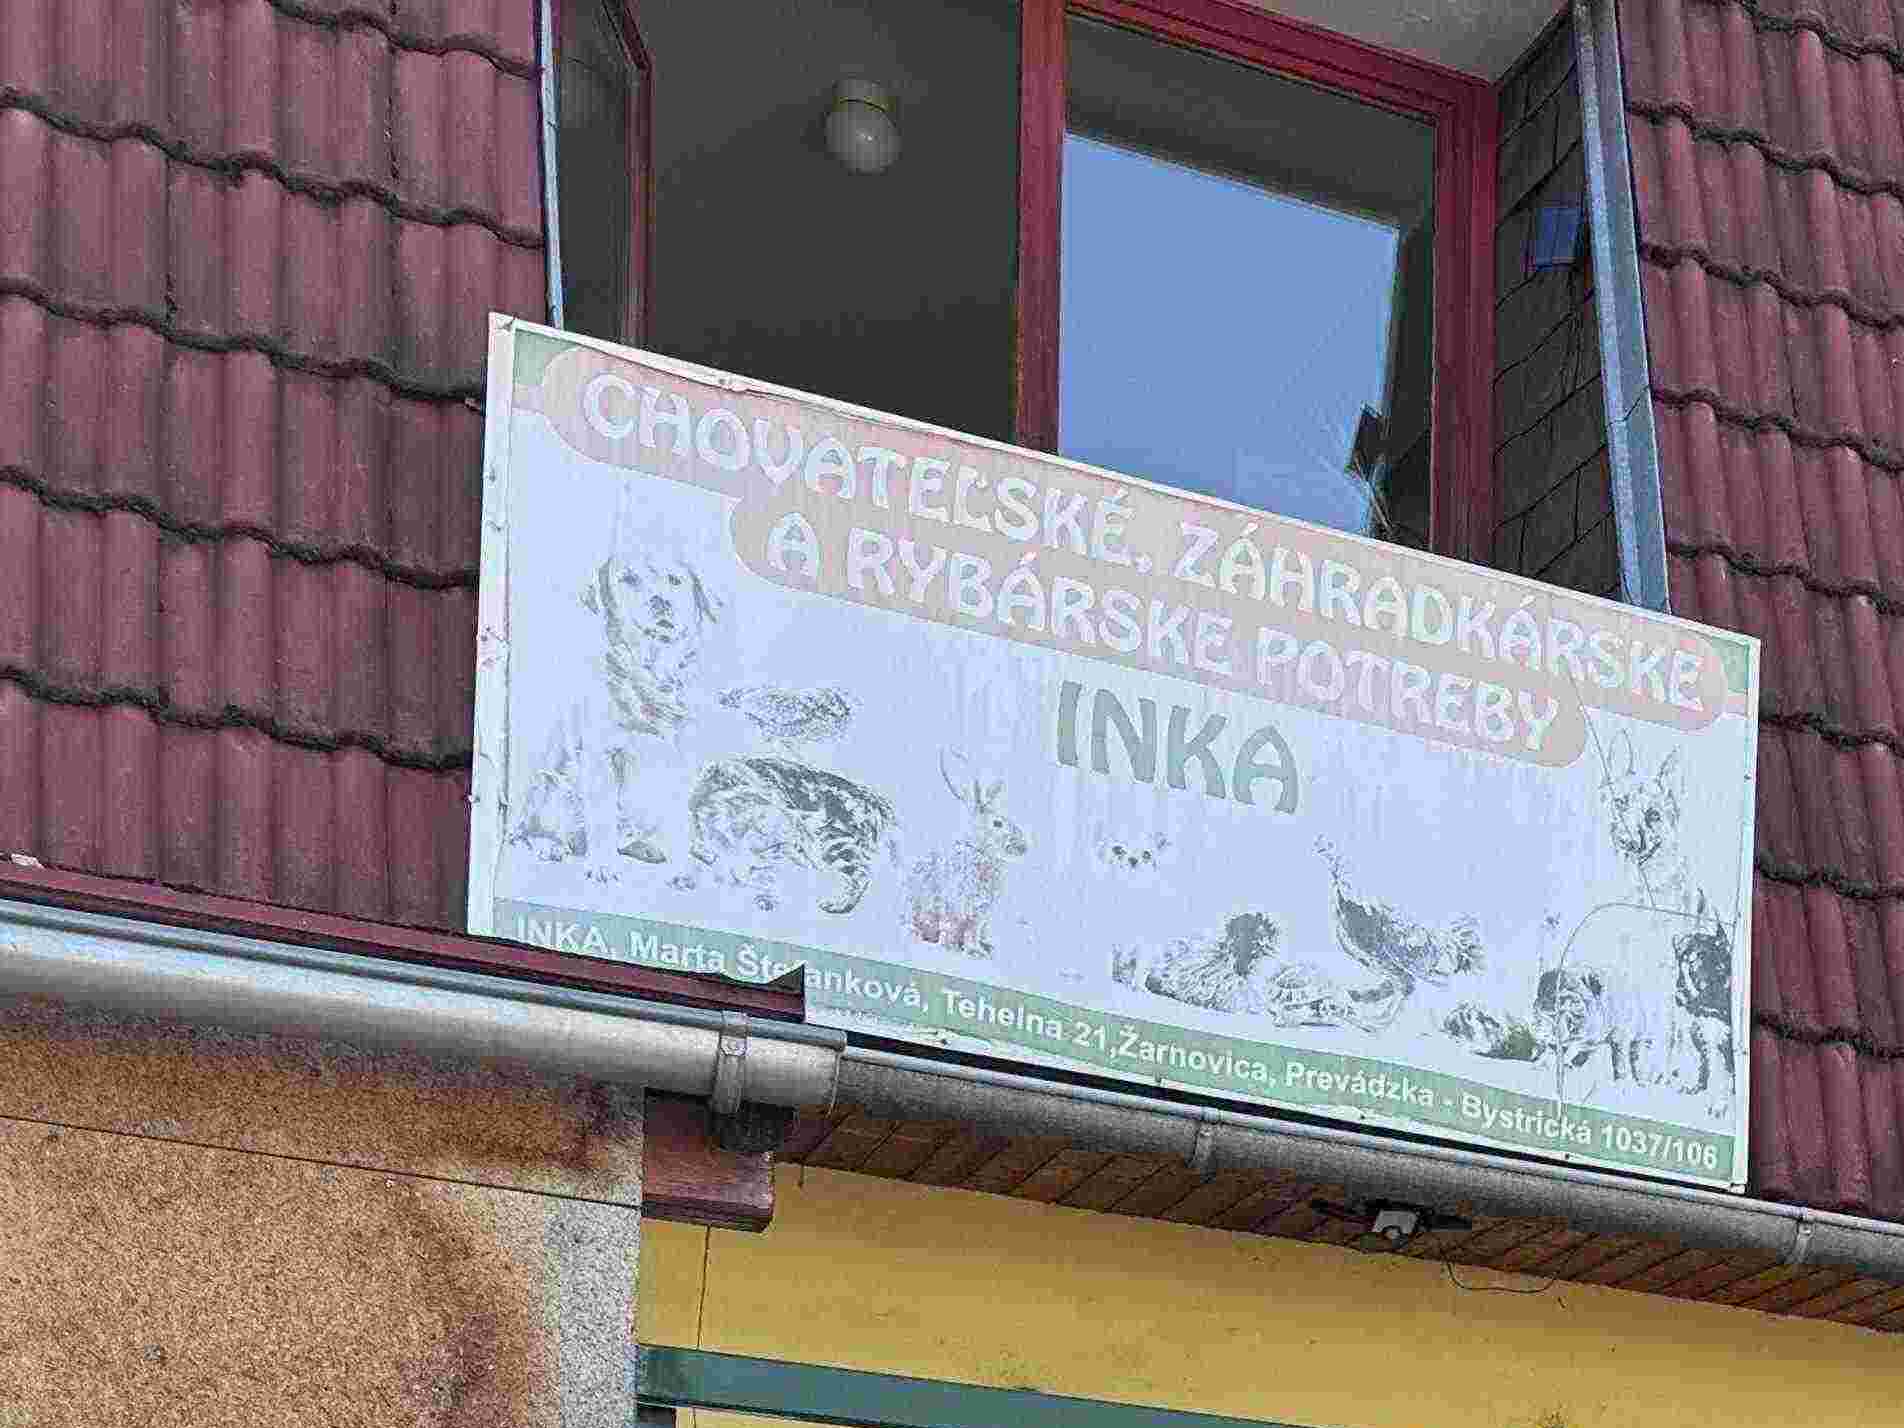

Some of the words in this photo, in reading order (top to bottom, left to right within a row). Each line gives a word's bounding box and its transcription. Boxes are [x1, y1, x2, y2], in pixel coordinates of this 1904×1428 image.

[765, 511, 821, 578] A
[846, 526, 1232, 673] RYBÁRSKE
[1255, 626, 1560, 752] POTREBY
[1056, 680, 1301, 815] INKA
[1461, 1091, 1593, 1145] Bystrická
[1602, 1122, 1718, 1169] 1037/106
